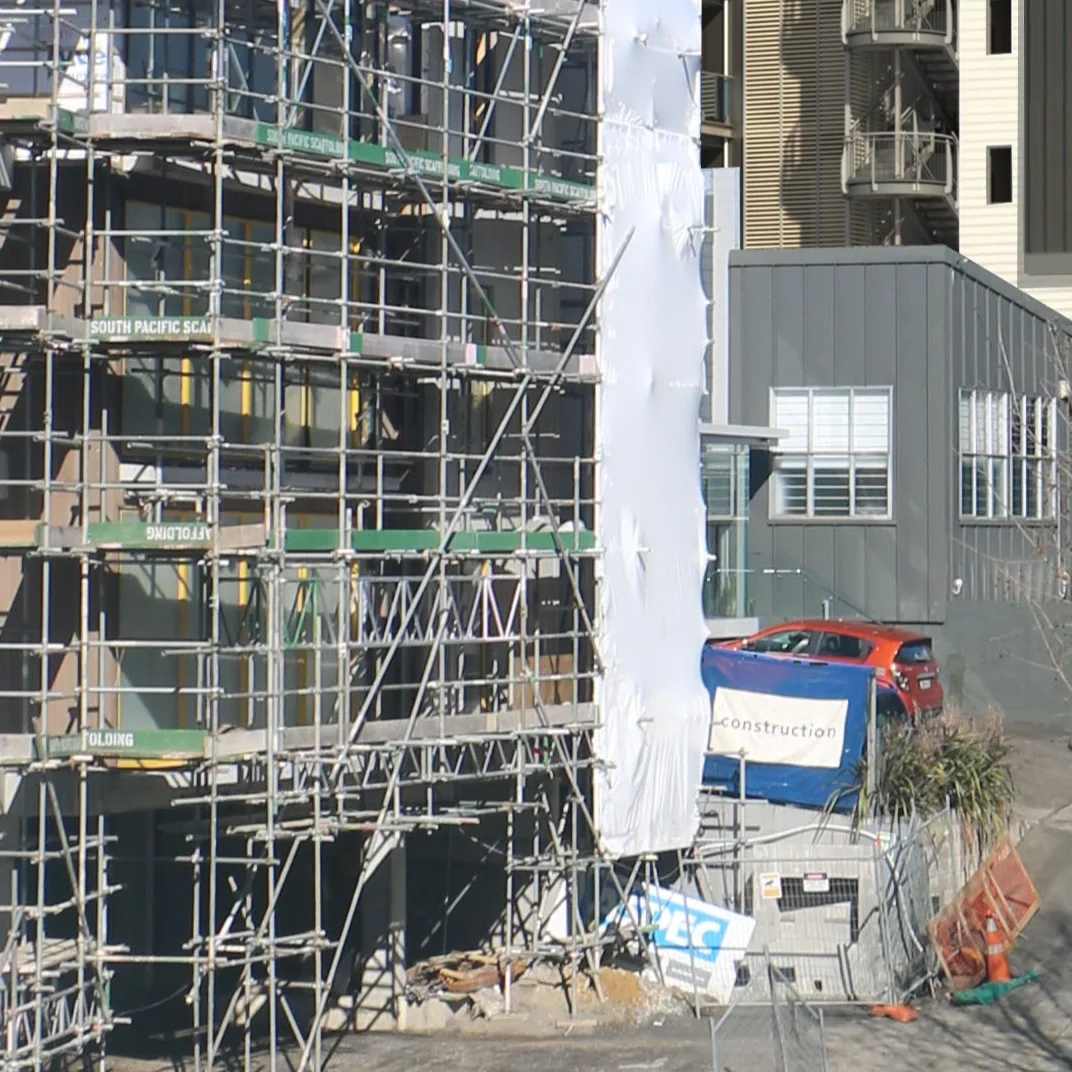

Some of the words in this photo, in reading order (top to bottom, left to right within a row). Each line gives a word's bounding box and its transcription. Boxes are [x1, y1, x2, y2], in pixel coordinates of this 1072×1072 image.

[91, 320, 132, 334] SOUTH
[134, 319, 182, 334] PACIFIC
[720, 715, 837, 739] construction
